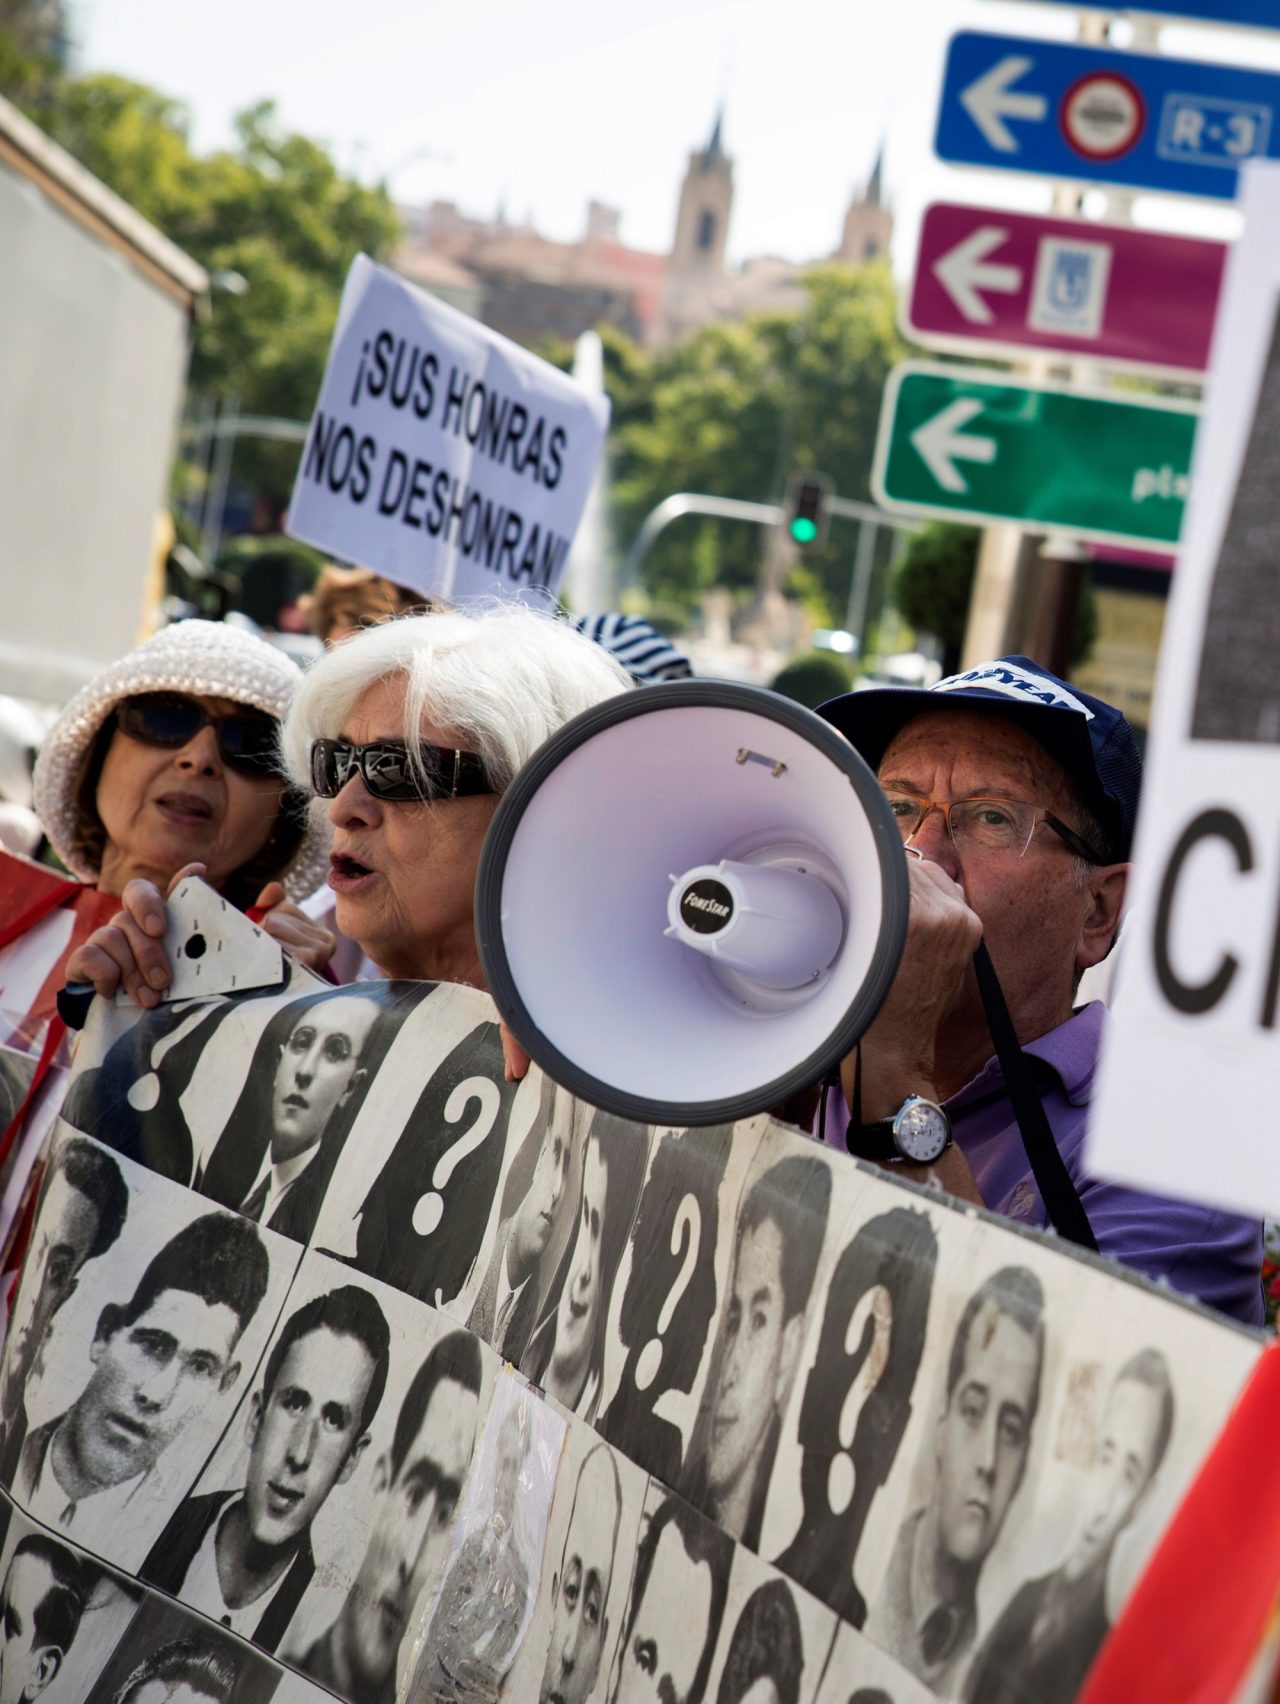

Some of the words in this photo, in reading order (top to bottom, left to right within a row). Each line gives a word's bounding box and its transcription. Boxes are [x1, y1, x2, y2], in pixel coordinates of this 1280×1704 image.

[304, 412, 376, 504] NOS
[351, 329, 440, 420] ¡SUS
[442, 367, 567, 491] HONRAS
